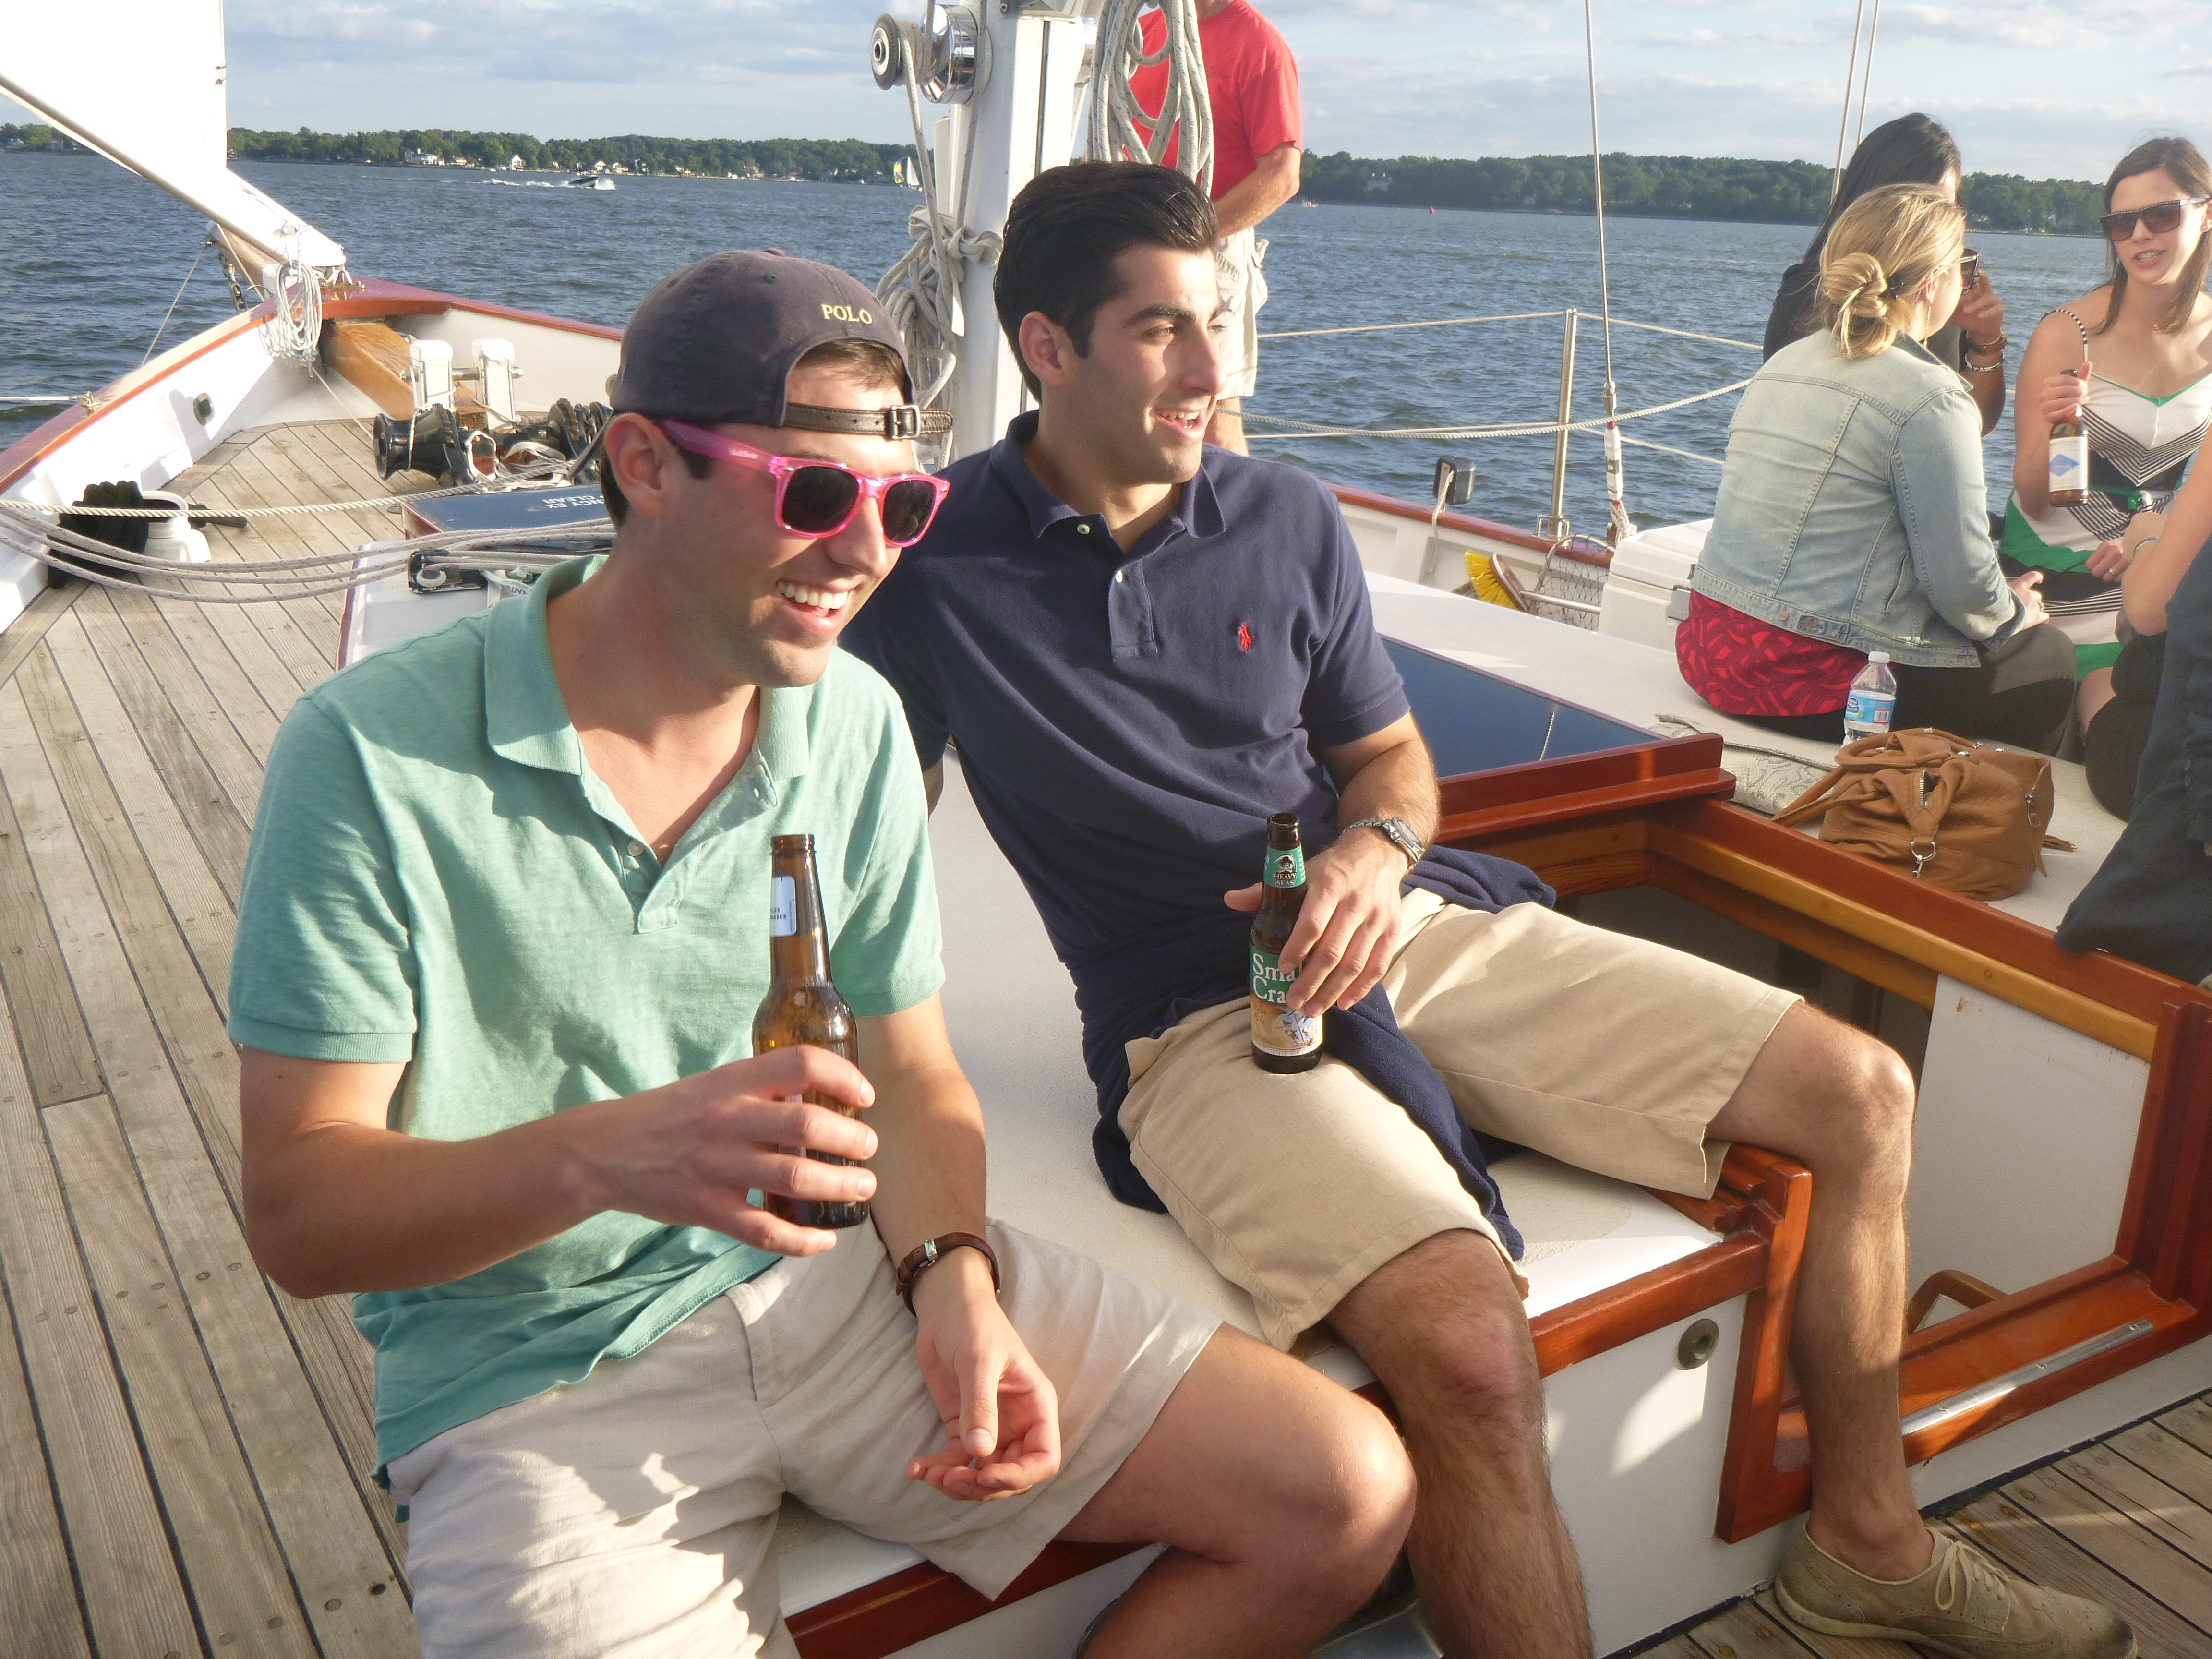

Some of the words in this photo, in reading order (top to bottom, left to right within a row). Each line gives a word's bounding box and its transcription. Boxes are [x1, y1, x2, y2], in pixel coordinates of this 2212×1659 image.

[820, 304, 872, 324] POLO
[542, 495, 595, 504] CLEAR
[1253, 975, 1287, 1004] Cra
